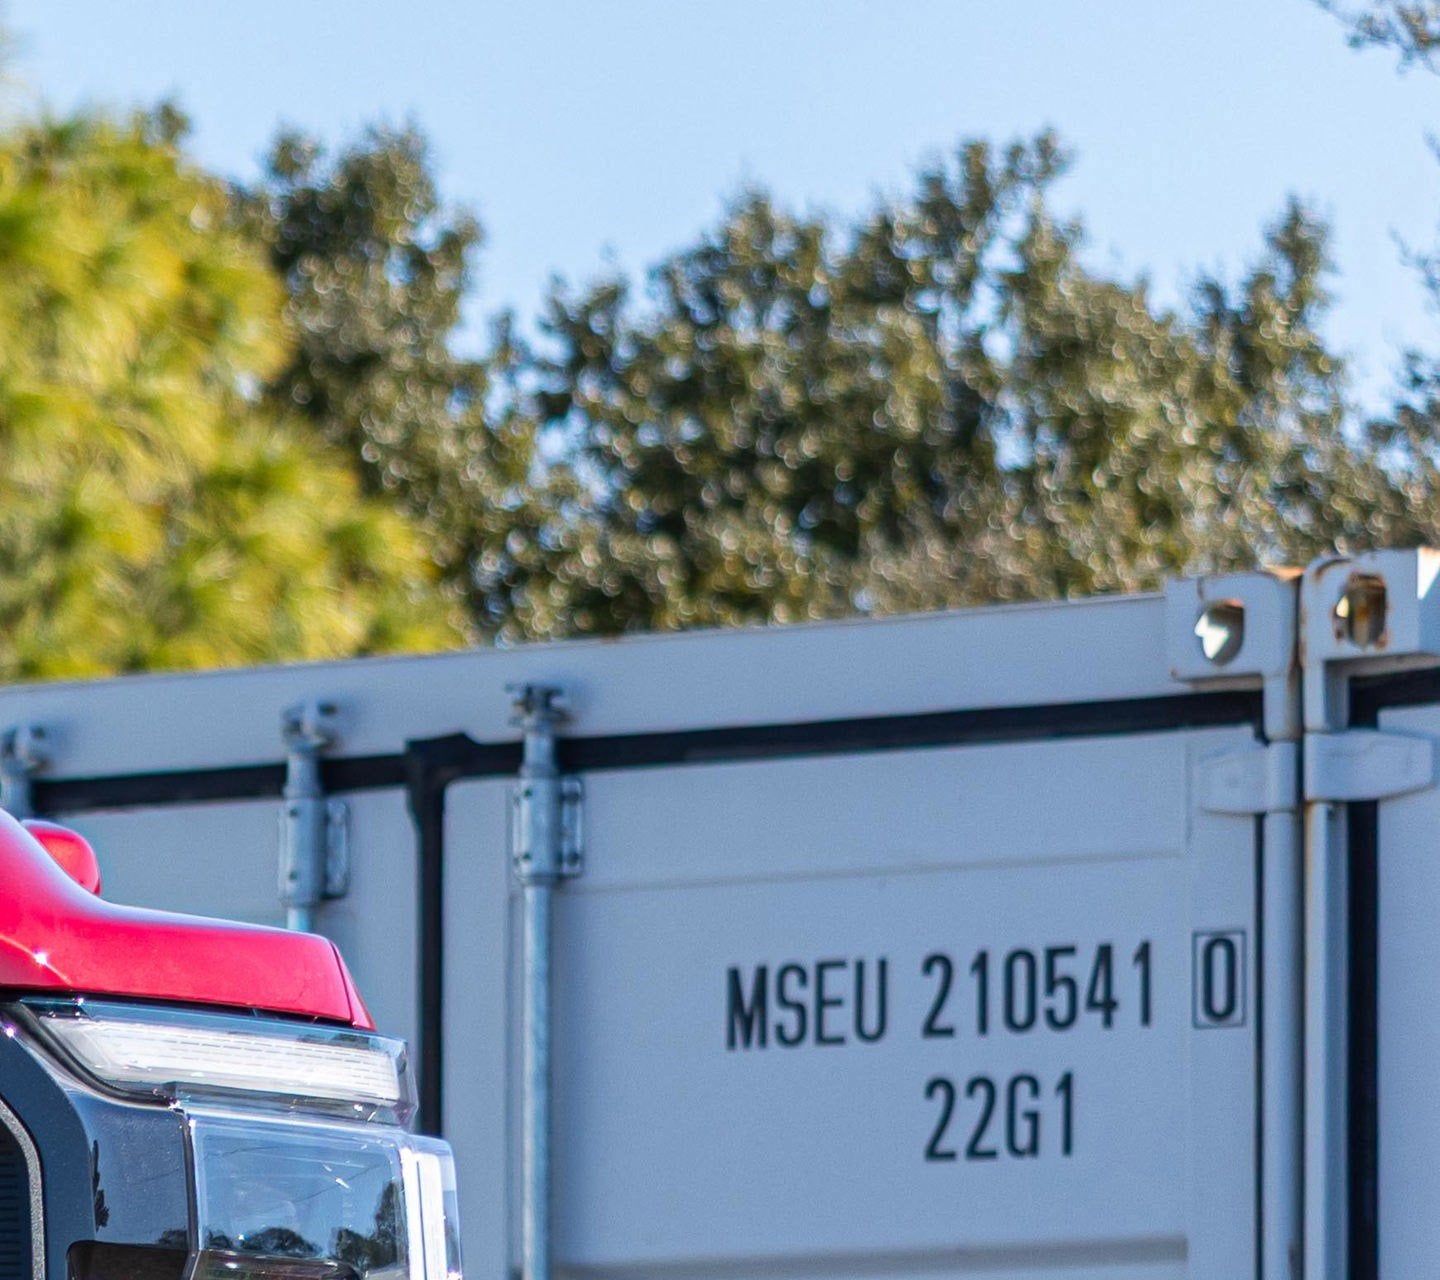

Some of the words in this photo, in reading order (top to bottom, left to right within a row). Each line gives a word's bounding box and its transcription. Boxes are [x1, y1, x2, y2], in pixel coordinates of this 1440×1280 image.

[725, 957, 888, 1051] MSEU
[920, 940, 1152, 1039] 210541
[1201, 934, 1236, 1022] 0
[924, 1071, 1075, 1162] 22G1
